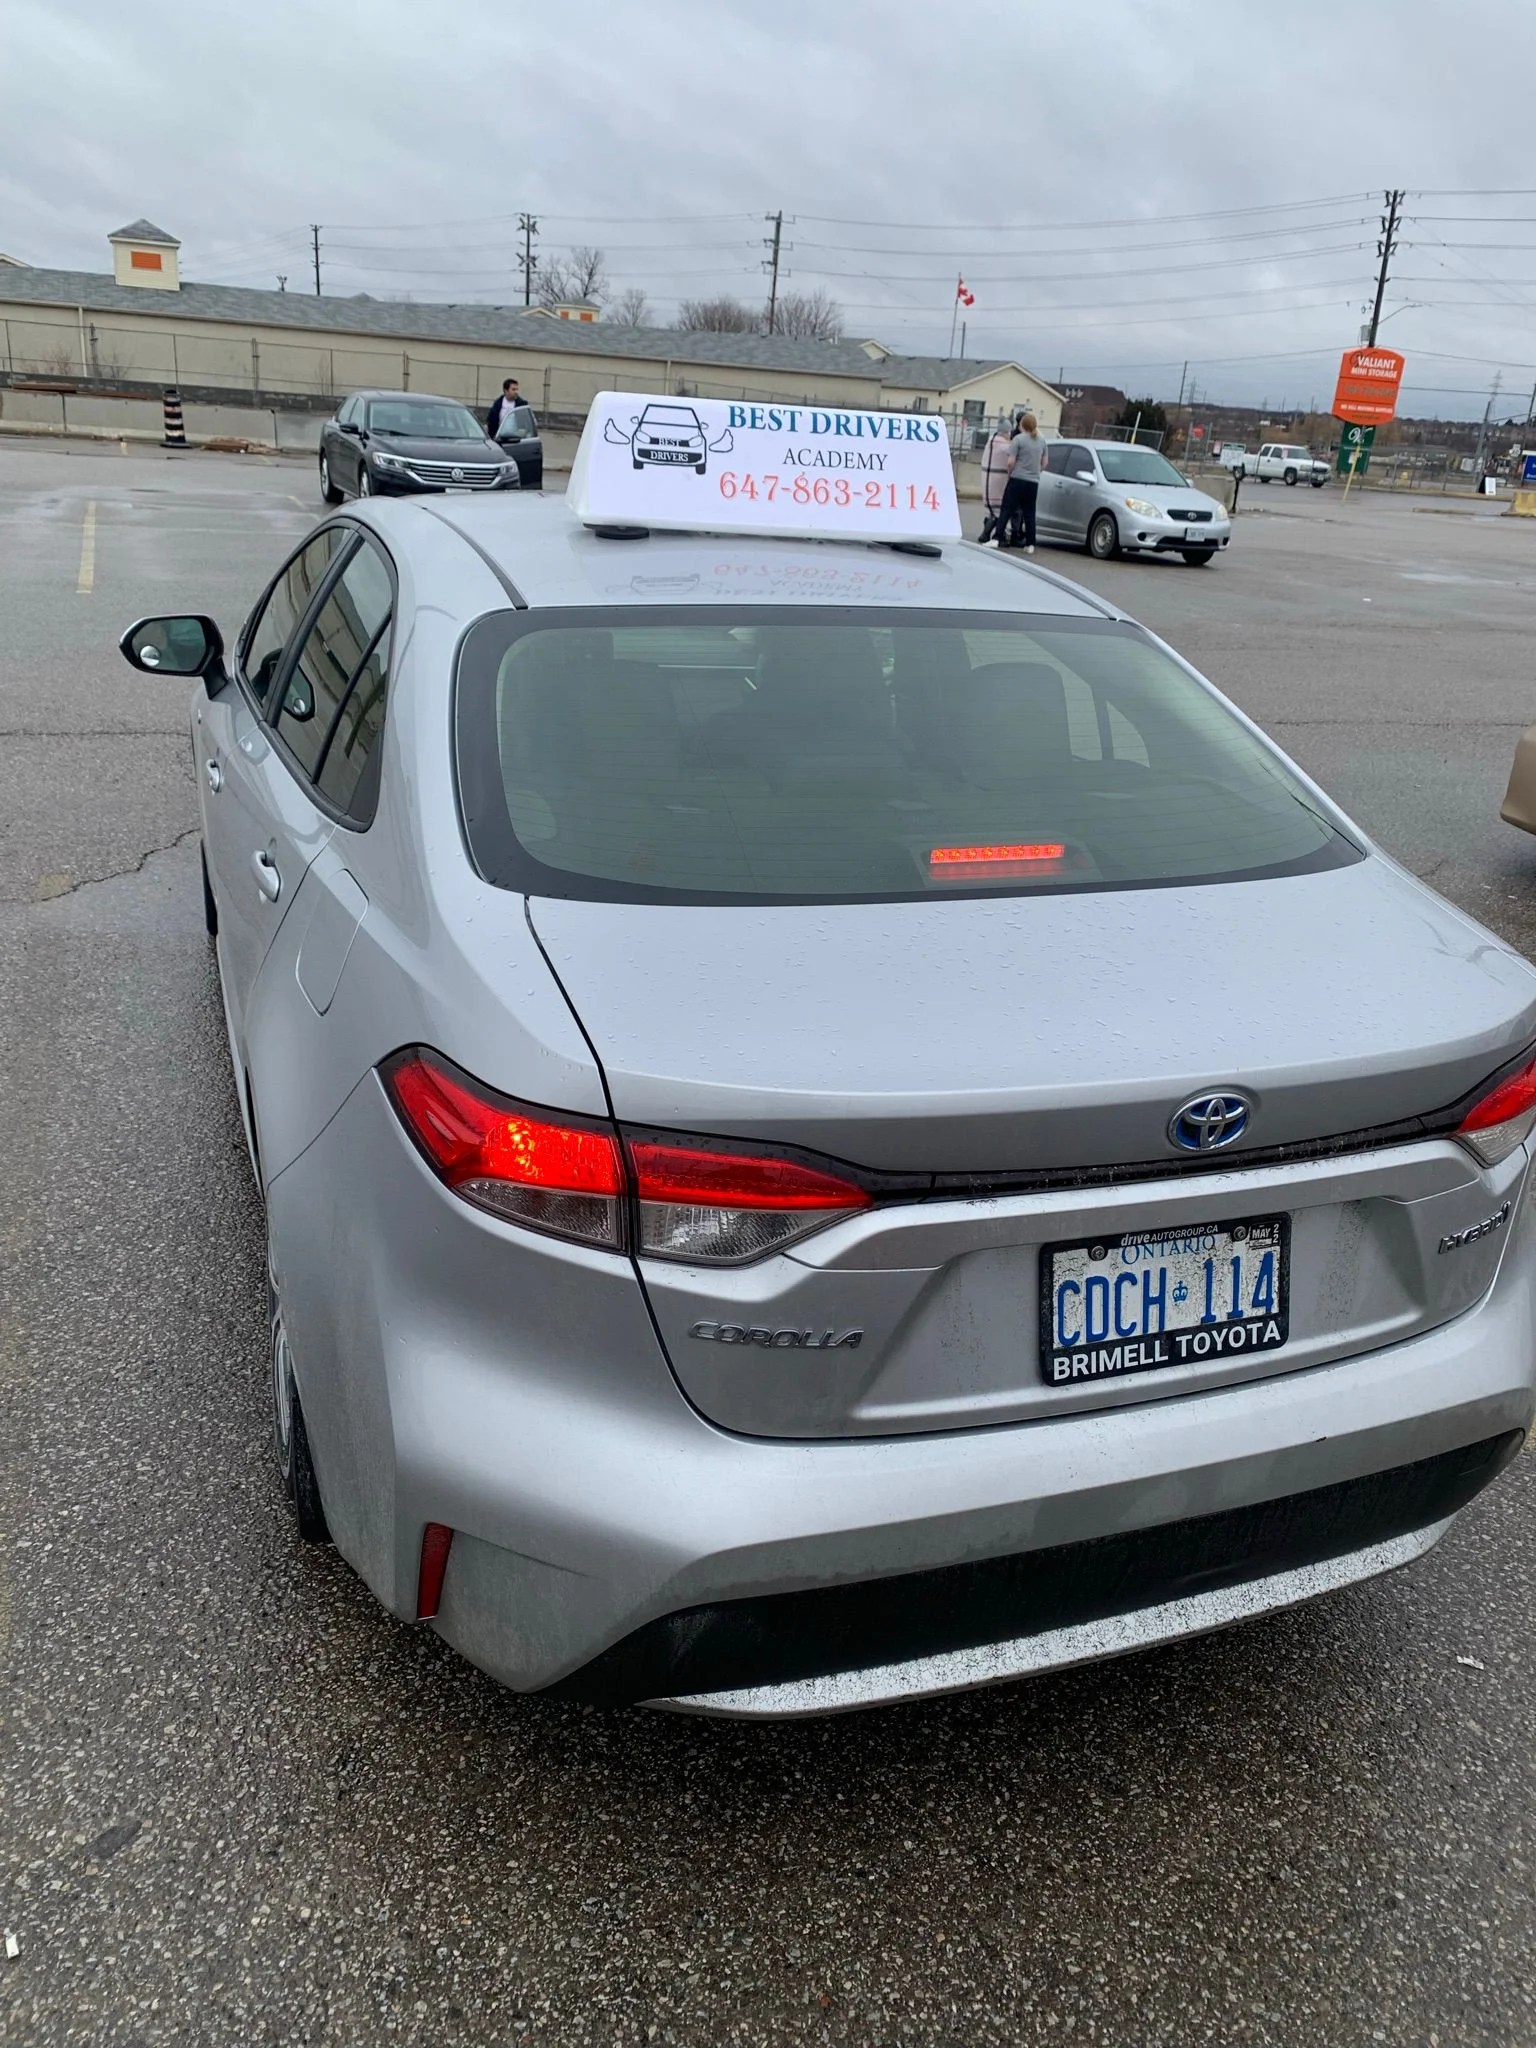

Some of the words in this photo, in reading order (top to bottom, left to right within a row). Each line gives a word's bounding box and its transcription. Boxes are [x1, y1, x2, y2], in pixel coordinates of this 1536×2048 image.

[1350, 367, 1367, 376] MINI
[1368, 368, 1398, 379] STORAGE
[1357, 355, 1396, 369] VALIANT
[727, 405, 802, 432] BEST
[810, 411, 940, 443] DRIVERS
[650, 450, 689, 462] DRIVERS
[659, 437, 681, 447] BEST
[782, 448, 888, 471] ACADEMY
[719, 471, 940, 511] 647-863-2114
[1121, 1234, 1215, 1265] ONTARIO
[1057, 1267, 1167, 1347] CDCH
[1201, 1250, 1274, 1324] 114
[688, 1319, 865, 1349] COROLLA
[1053, 1339, 1169, 1381] BRIMELL
[1175, 1320, 1281, 1358] TOYOTA
